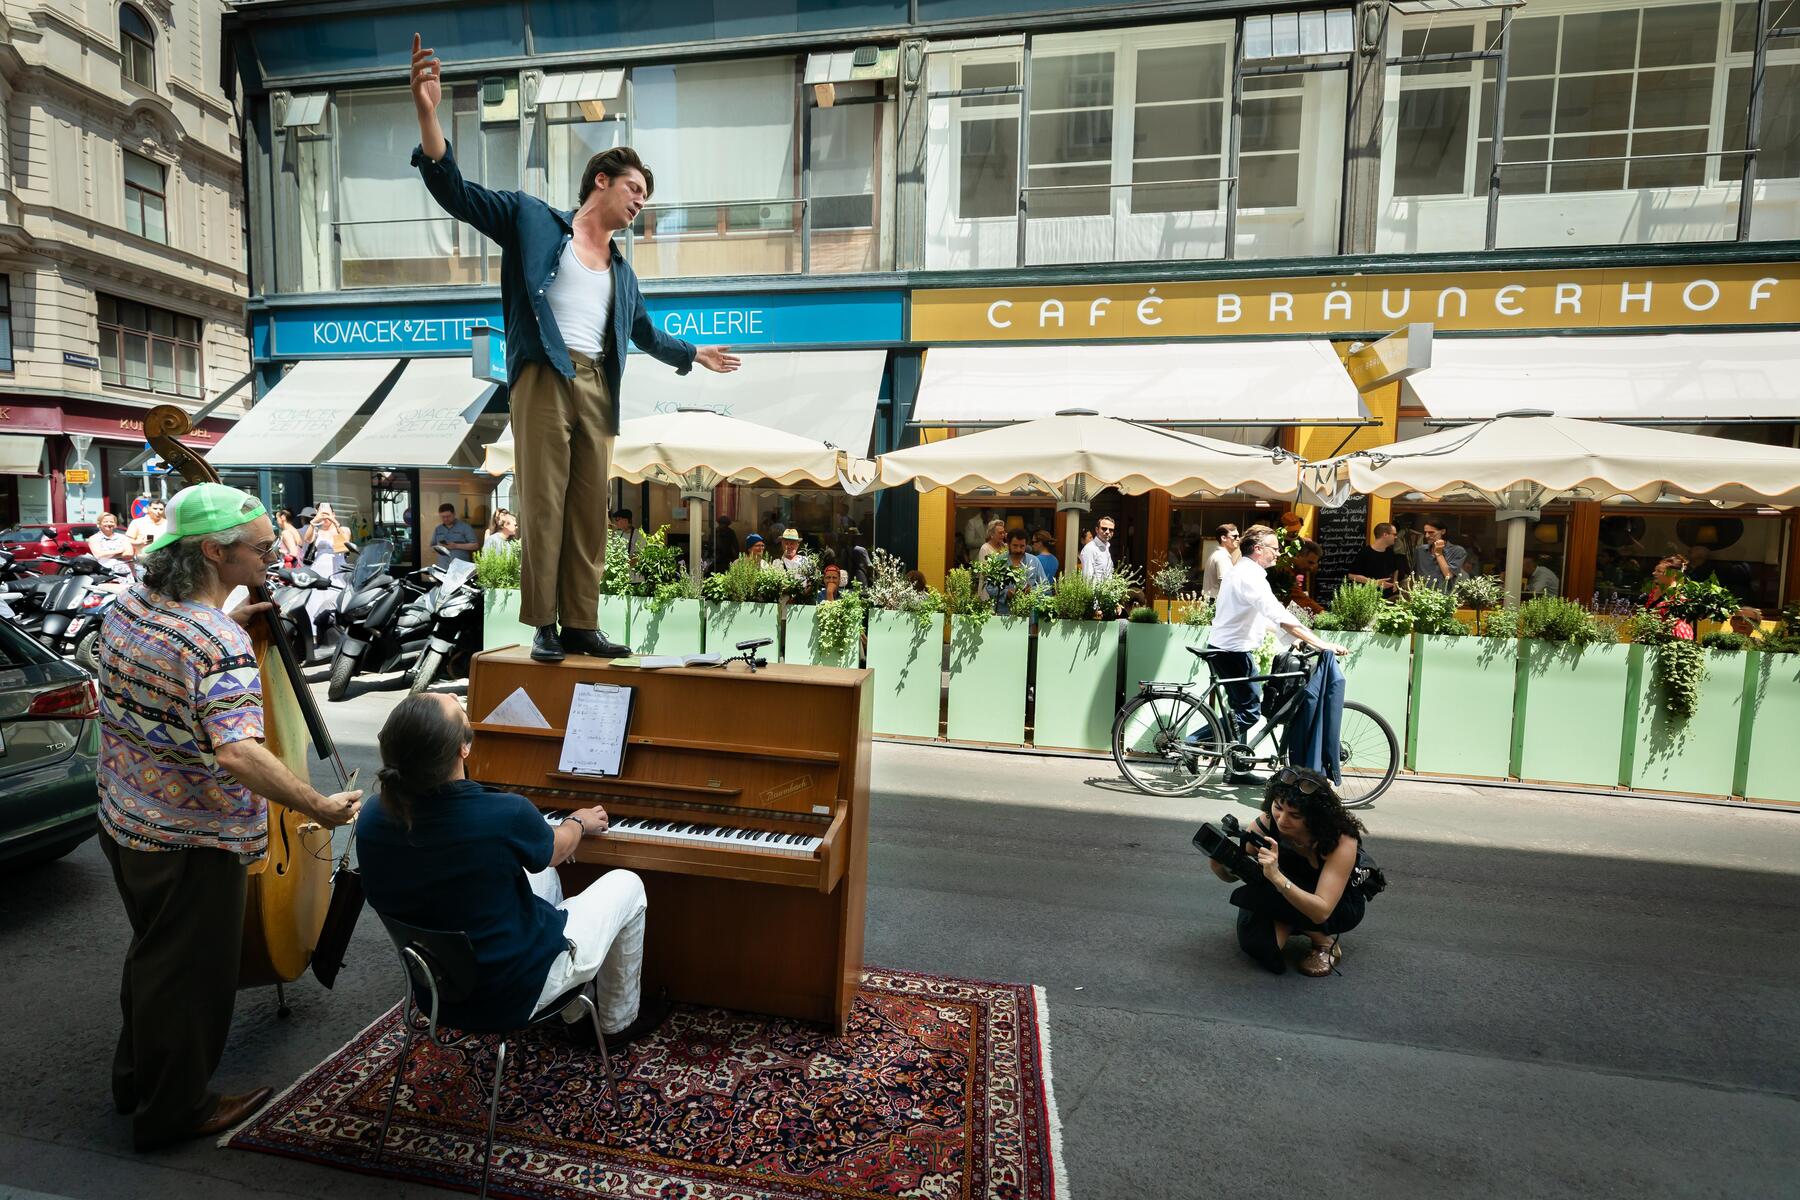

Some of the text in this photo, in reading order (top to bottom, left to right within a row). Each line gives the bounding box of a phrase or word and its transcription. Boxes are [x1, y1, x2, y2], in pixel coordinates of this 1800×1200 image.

[987, 277, 1779, 328] CAFÉ BRÄUNERHOF
[664, 310, 764, 336] GALERIE
[46, 742, 66, 751] TDI
